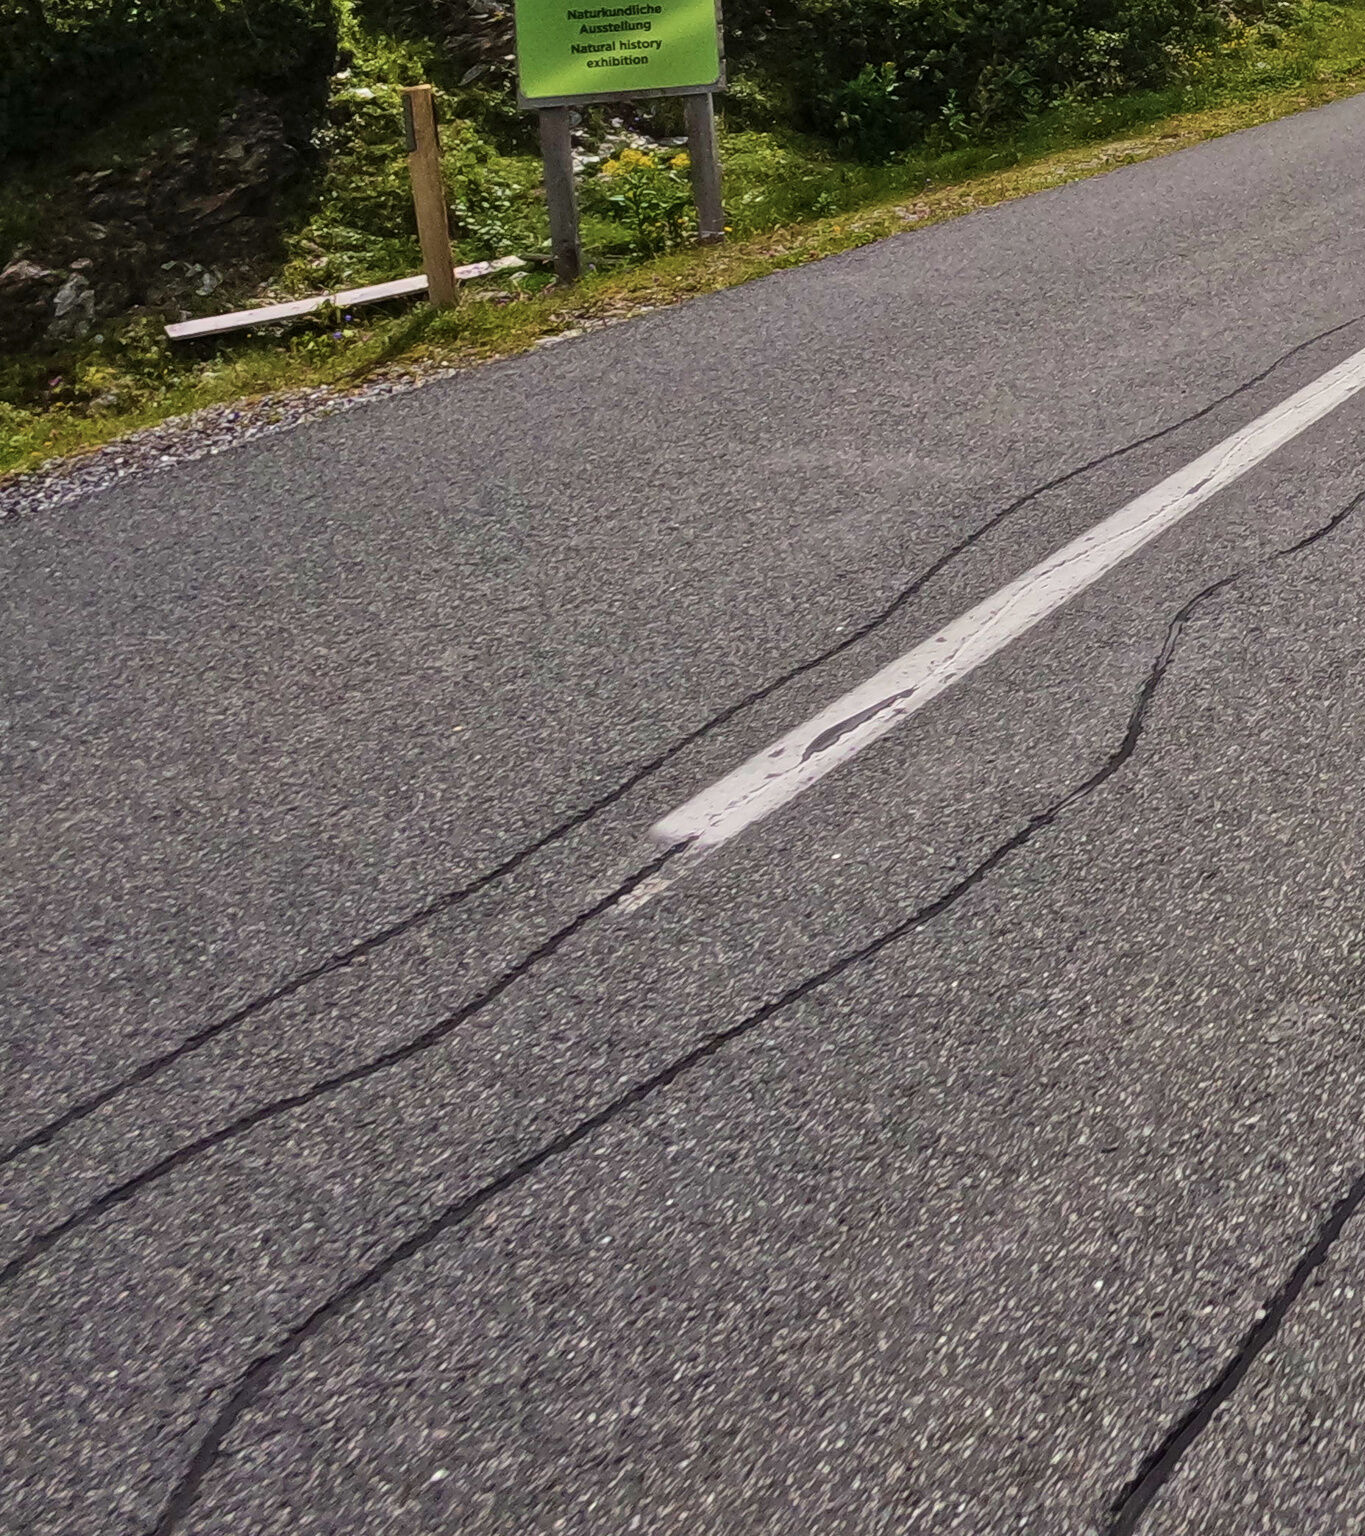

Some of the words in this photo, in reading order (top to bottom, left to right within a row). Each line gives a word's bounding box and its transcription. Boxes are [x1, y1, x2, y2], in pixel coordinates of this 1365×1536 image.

[567, 4, 662, 20] Naturkundliche
[580, 20, 652, 35] Ausstellung
[571, 41, 616, 54] Natural
[619, 39, 662, 50] history
[586, 55, 649, 68] exhibition
